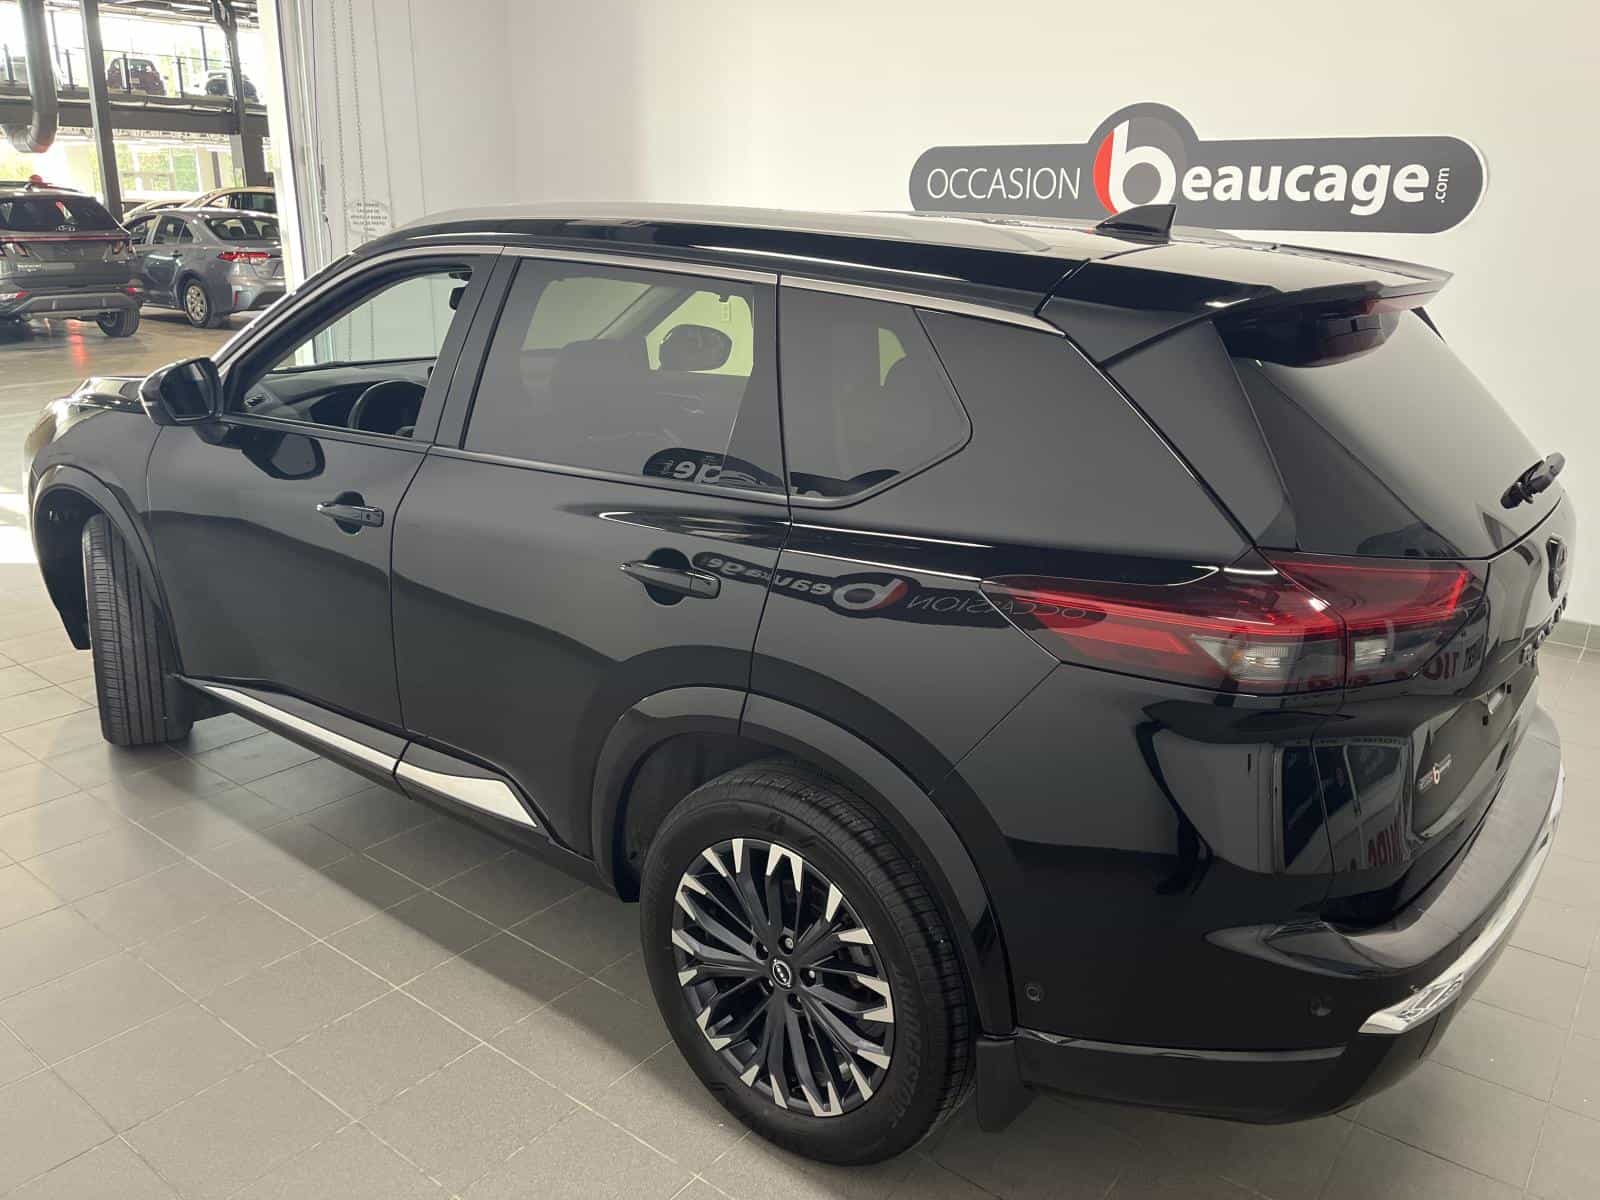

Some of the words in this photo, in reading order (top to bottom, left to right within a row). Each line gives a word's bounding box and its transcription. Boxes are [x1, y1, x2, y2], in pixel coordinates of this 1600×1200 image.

[927, 168, 1080, 199] OCCASION
[1108, 119, 1430, 216] beaucage
[1435, 167, 1450, 204] .com
